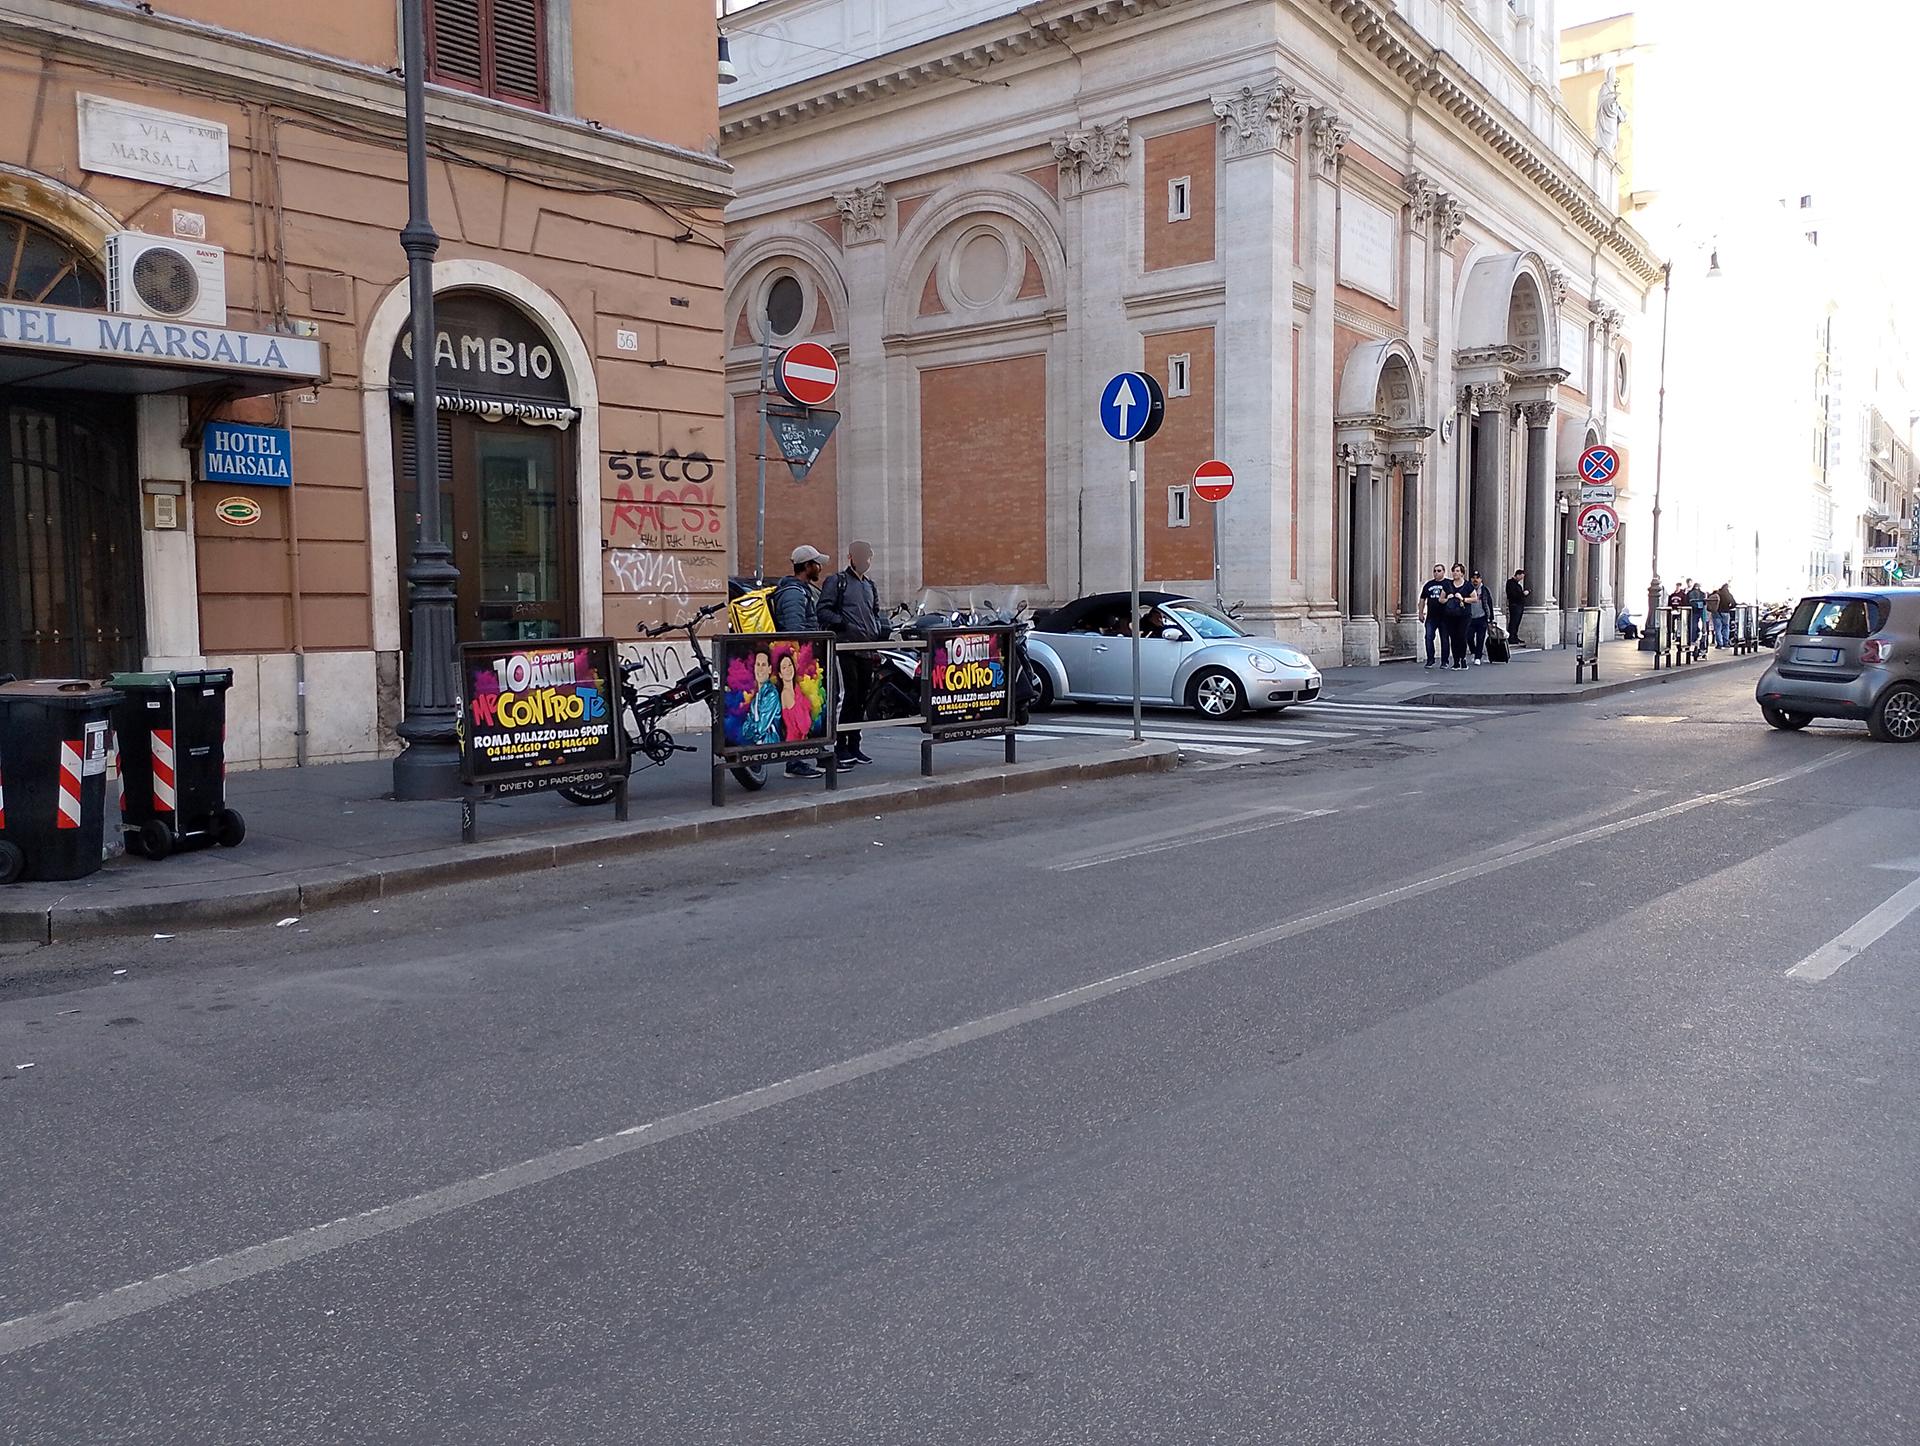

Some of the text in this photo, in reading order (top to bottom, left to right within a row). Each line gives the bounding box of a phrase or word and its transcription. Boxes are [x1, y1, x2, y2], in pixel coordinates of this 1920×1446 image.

[140, 122, 171, 143] VIA
[110, 142, 199, 174] MARSALA
[196, 250, 218, 259] SANYO
[97, 317, 288, 369] MARSALA
[215, 430, 281, 455] HOTEL
[208, 453, 289, 478] MARSALA
[608, 449, 714, 483] SECO
[531, 651, 575, 665] LO SHOW DEI
[945, 637, 990, 665] 10 ANNI
[493, 655, 576, 693] 10 ANNI
[931, 694, 952, 706] ROMA
[953, 692, 977, 703] PALAZZO
[990, 690, 1006, 699] SPORT
[474, 724, 609, 749] ROMA PALAZZO DELLO SPORT
[487, 746, 501, 757] 04
[502, 742, 541, 755] MAGGIO
[548, 740, 561, 750] 05
[562, 736, 599, 748] MAGGIO
[742, 747, 819, 762] DIVIETO DI PARCHEGGIO
[500, 772, 603, 792] DIVIETO DI PARCHEGGIO
